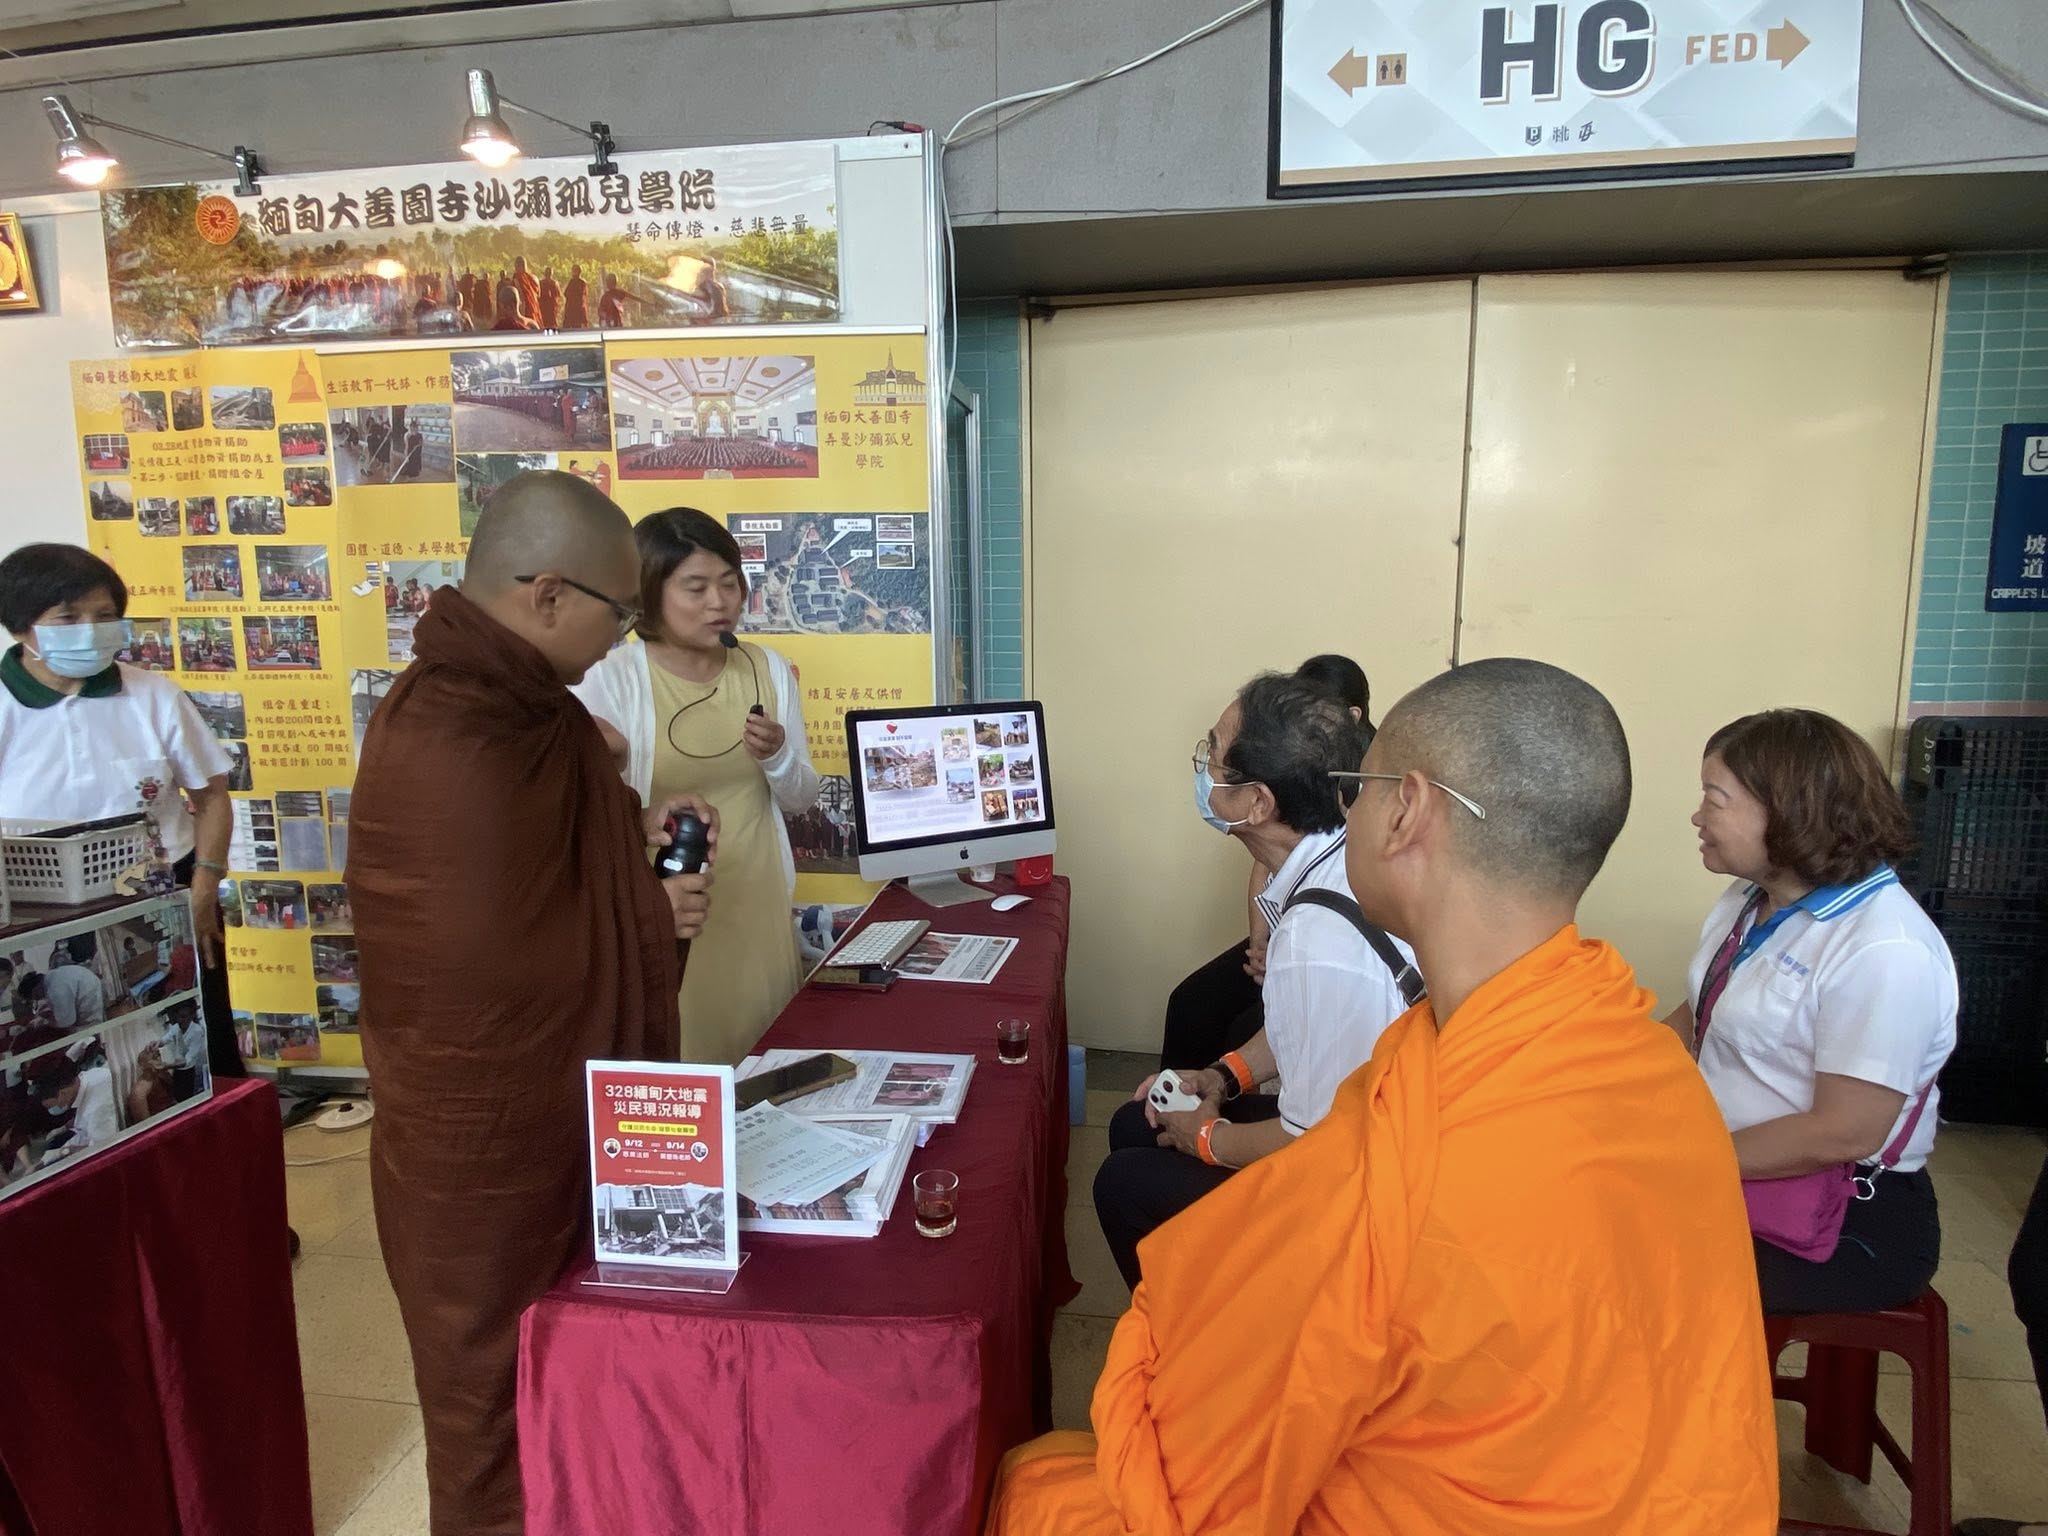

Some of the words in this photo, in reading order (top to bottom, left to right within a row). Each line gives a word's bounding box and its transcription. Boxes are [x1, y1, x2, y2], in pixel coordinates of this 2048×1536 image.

[1480, 0, 1656, 105] HG
[1686, 32, 1758, 66] FED
[257, 169, 717, 236] 緬甸大善園寺沙彌孤兒學院
[824, 409, 912, 426] 緬甸大善園寺
[855, 454, 885, 469] 學院
[2020, 534, 2047, 578] 坡道
[808, 688, 902, 700] 結夏安居及供僧
[316, 758, 333, 767] 100
[605, 1084, 708, 1104] 328緬甸大地震
[613, 1100, 702, 1119] 災民現況報導
[625, 1138, 644, 1148] 9/12
[666, 1141, 685, 1151] 9/14
